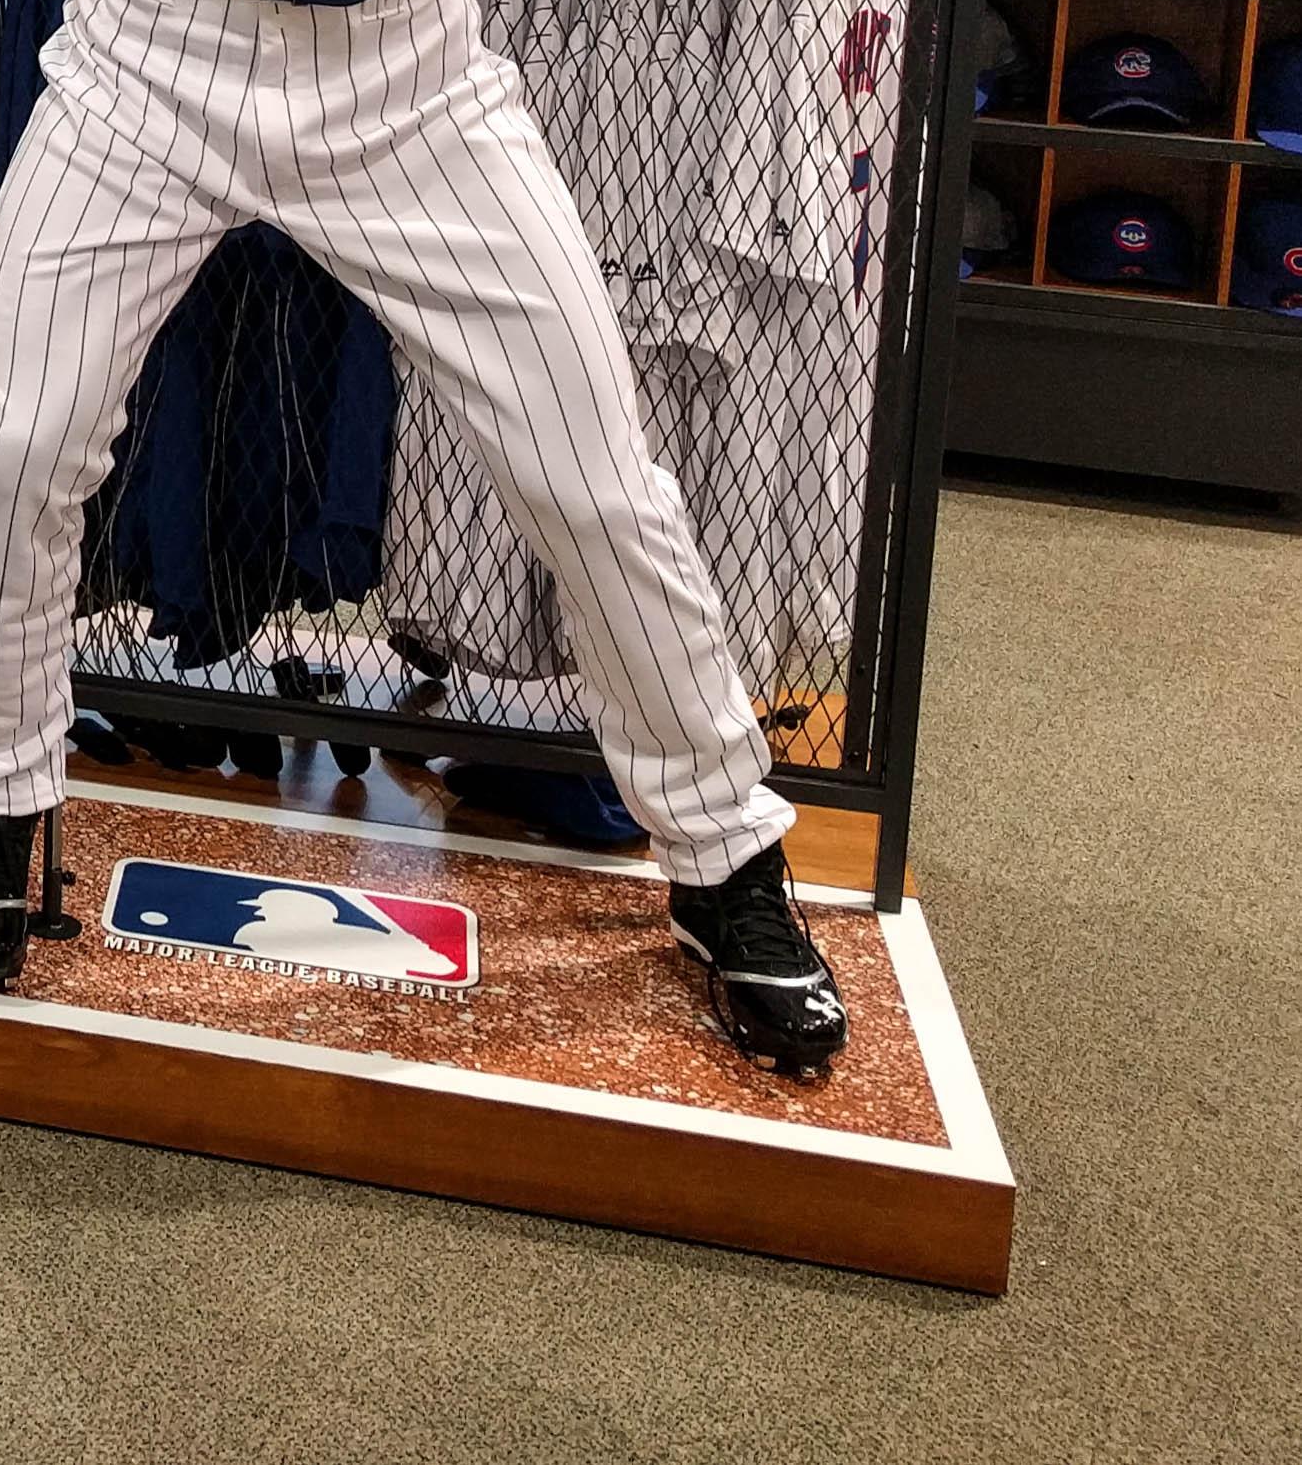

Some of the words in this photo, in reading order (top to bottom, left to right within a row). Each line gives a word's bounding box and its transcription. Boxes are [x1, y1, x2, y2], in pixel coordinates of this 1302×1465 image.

[104, 936, 195, 964] MAJOR
[207, 952, 320, 982] LEAGUE
[325, 969, 471, 1006] BASEBALL
